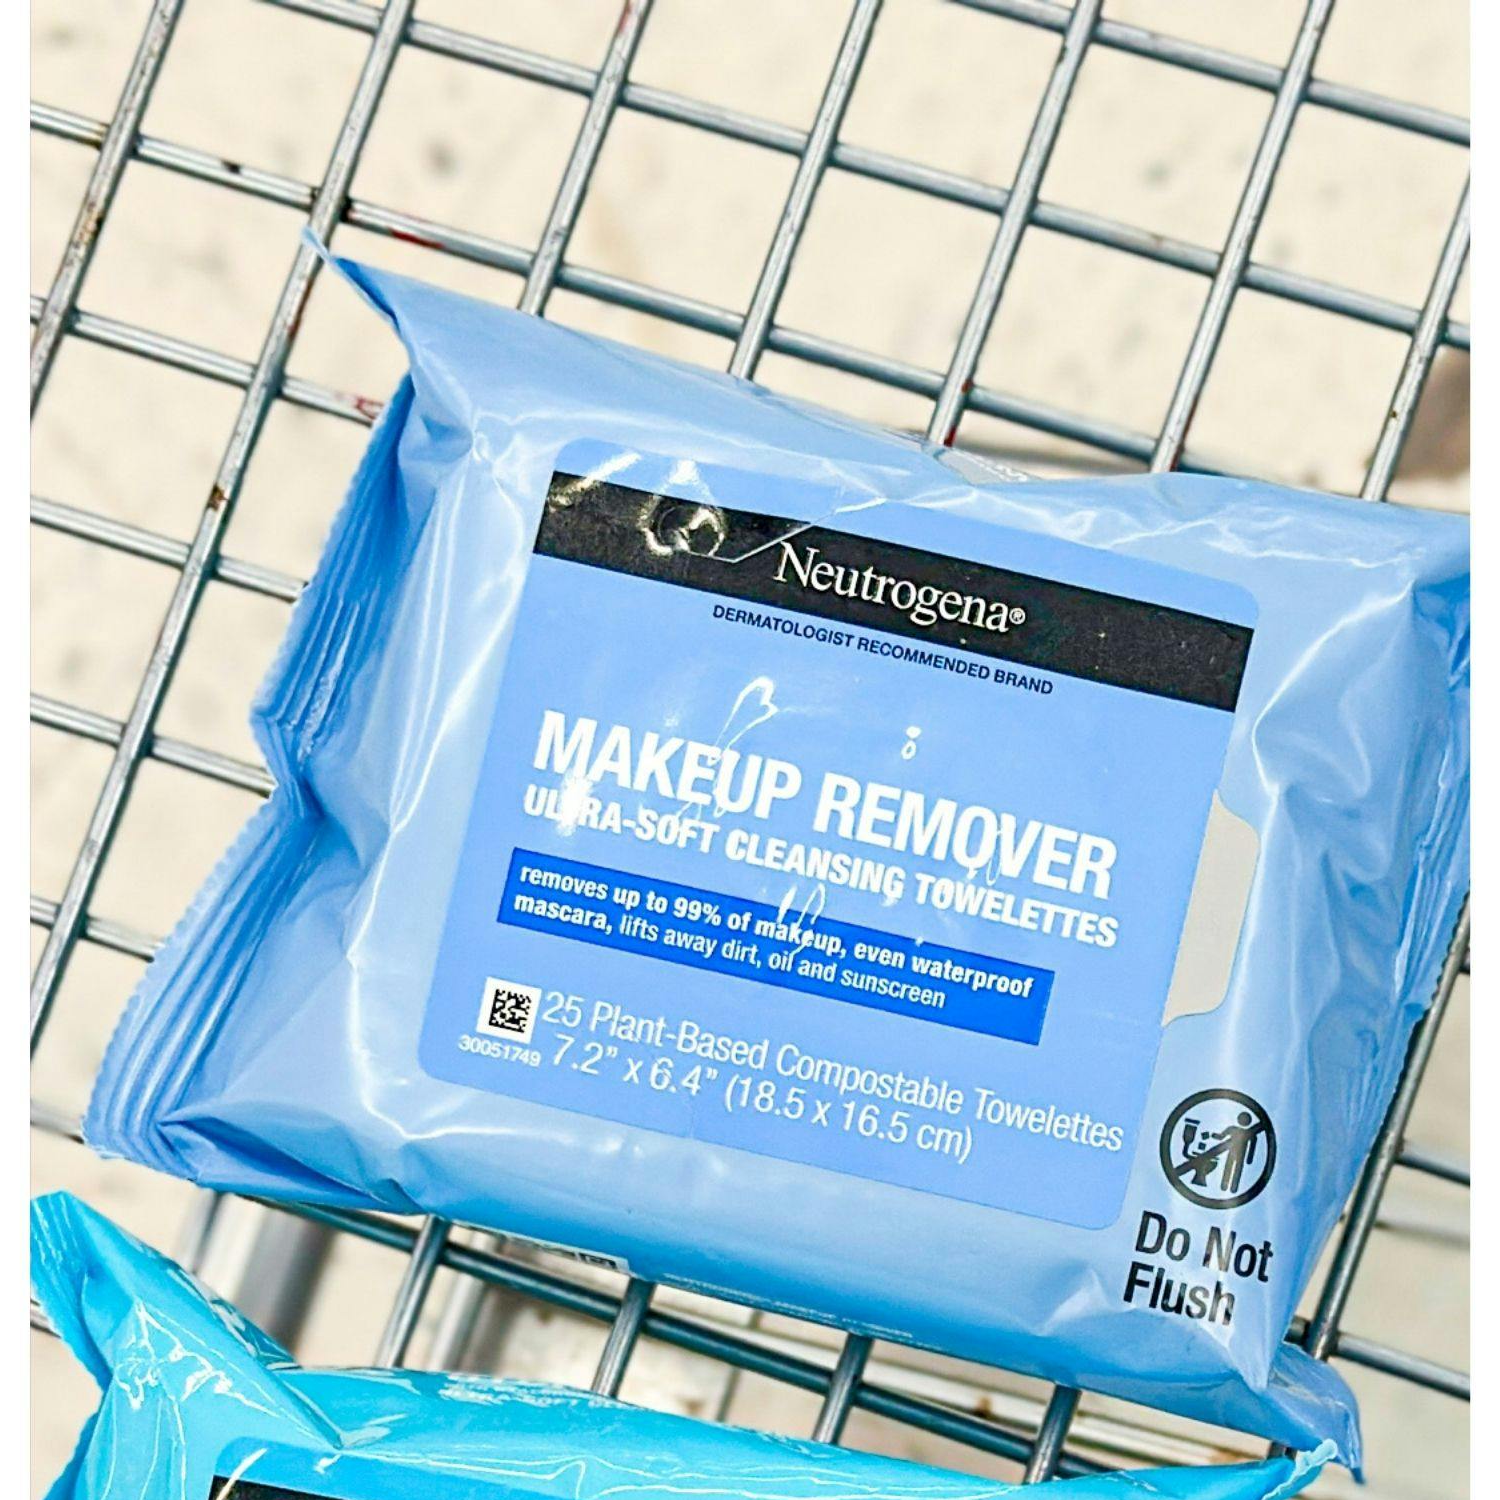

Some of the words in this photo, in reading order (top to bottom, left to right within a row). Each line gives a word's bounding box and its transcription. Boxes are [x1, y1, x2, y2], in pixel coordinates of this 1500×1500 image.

[712, 604, 854, 649] DERMATOLOGIST
[856, 635, 991, 680] RECOMMENDED
[992, 668, 1054, 696] BRAND
[534, 710, 801, 821] MAKEUP
[812, 772, 1118, 900] REMOVER
[520, 864, 608, 902] removes
[673, 898, 722, 927] 99%
[854, 941, 904, 968] even
[911, 949, 1033, 999] waterproof
[725, 828, 905, 900] CLEANSING
[916, 871, 1118, 949] TOWELETTES
[514, 895, 612, 937] mascara,
[618, 914, 658, 944] lifts
[663, 928, 718, 960] away
[722, 937, 762, 968] dirt,
[841, 967, 946, 1009] sunscreen
[458, 1035, 541, 1067] 30051749
[540, 991, 584, 1027] 25
[589, 1001, 768, 1070] Plant-Based
[775, 1045, 965, 1116] Compostable
[975, 1089, 1123, 1151] Towelettes
[723, 1076, 804, 1122] (18.5
[841, 1101, 908, 1143] 16.5
[1123, 1261, 1235, 1325] Flush
[1135, 1211, 1190, 1261] Do
[1203, 1226, 1273, 1282] Not
